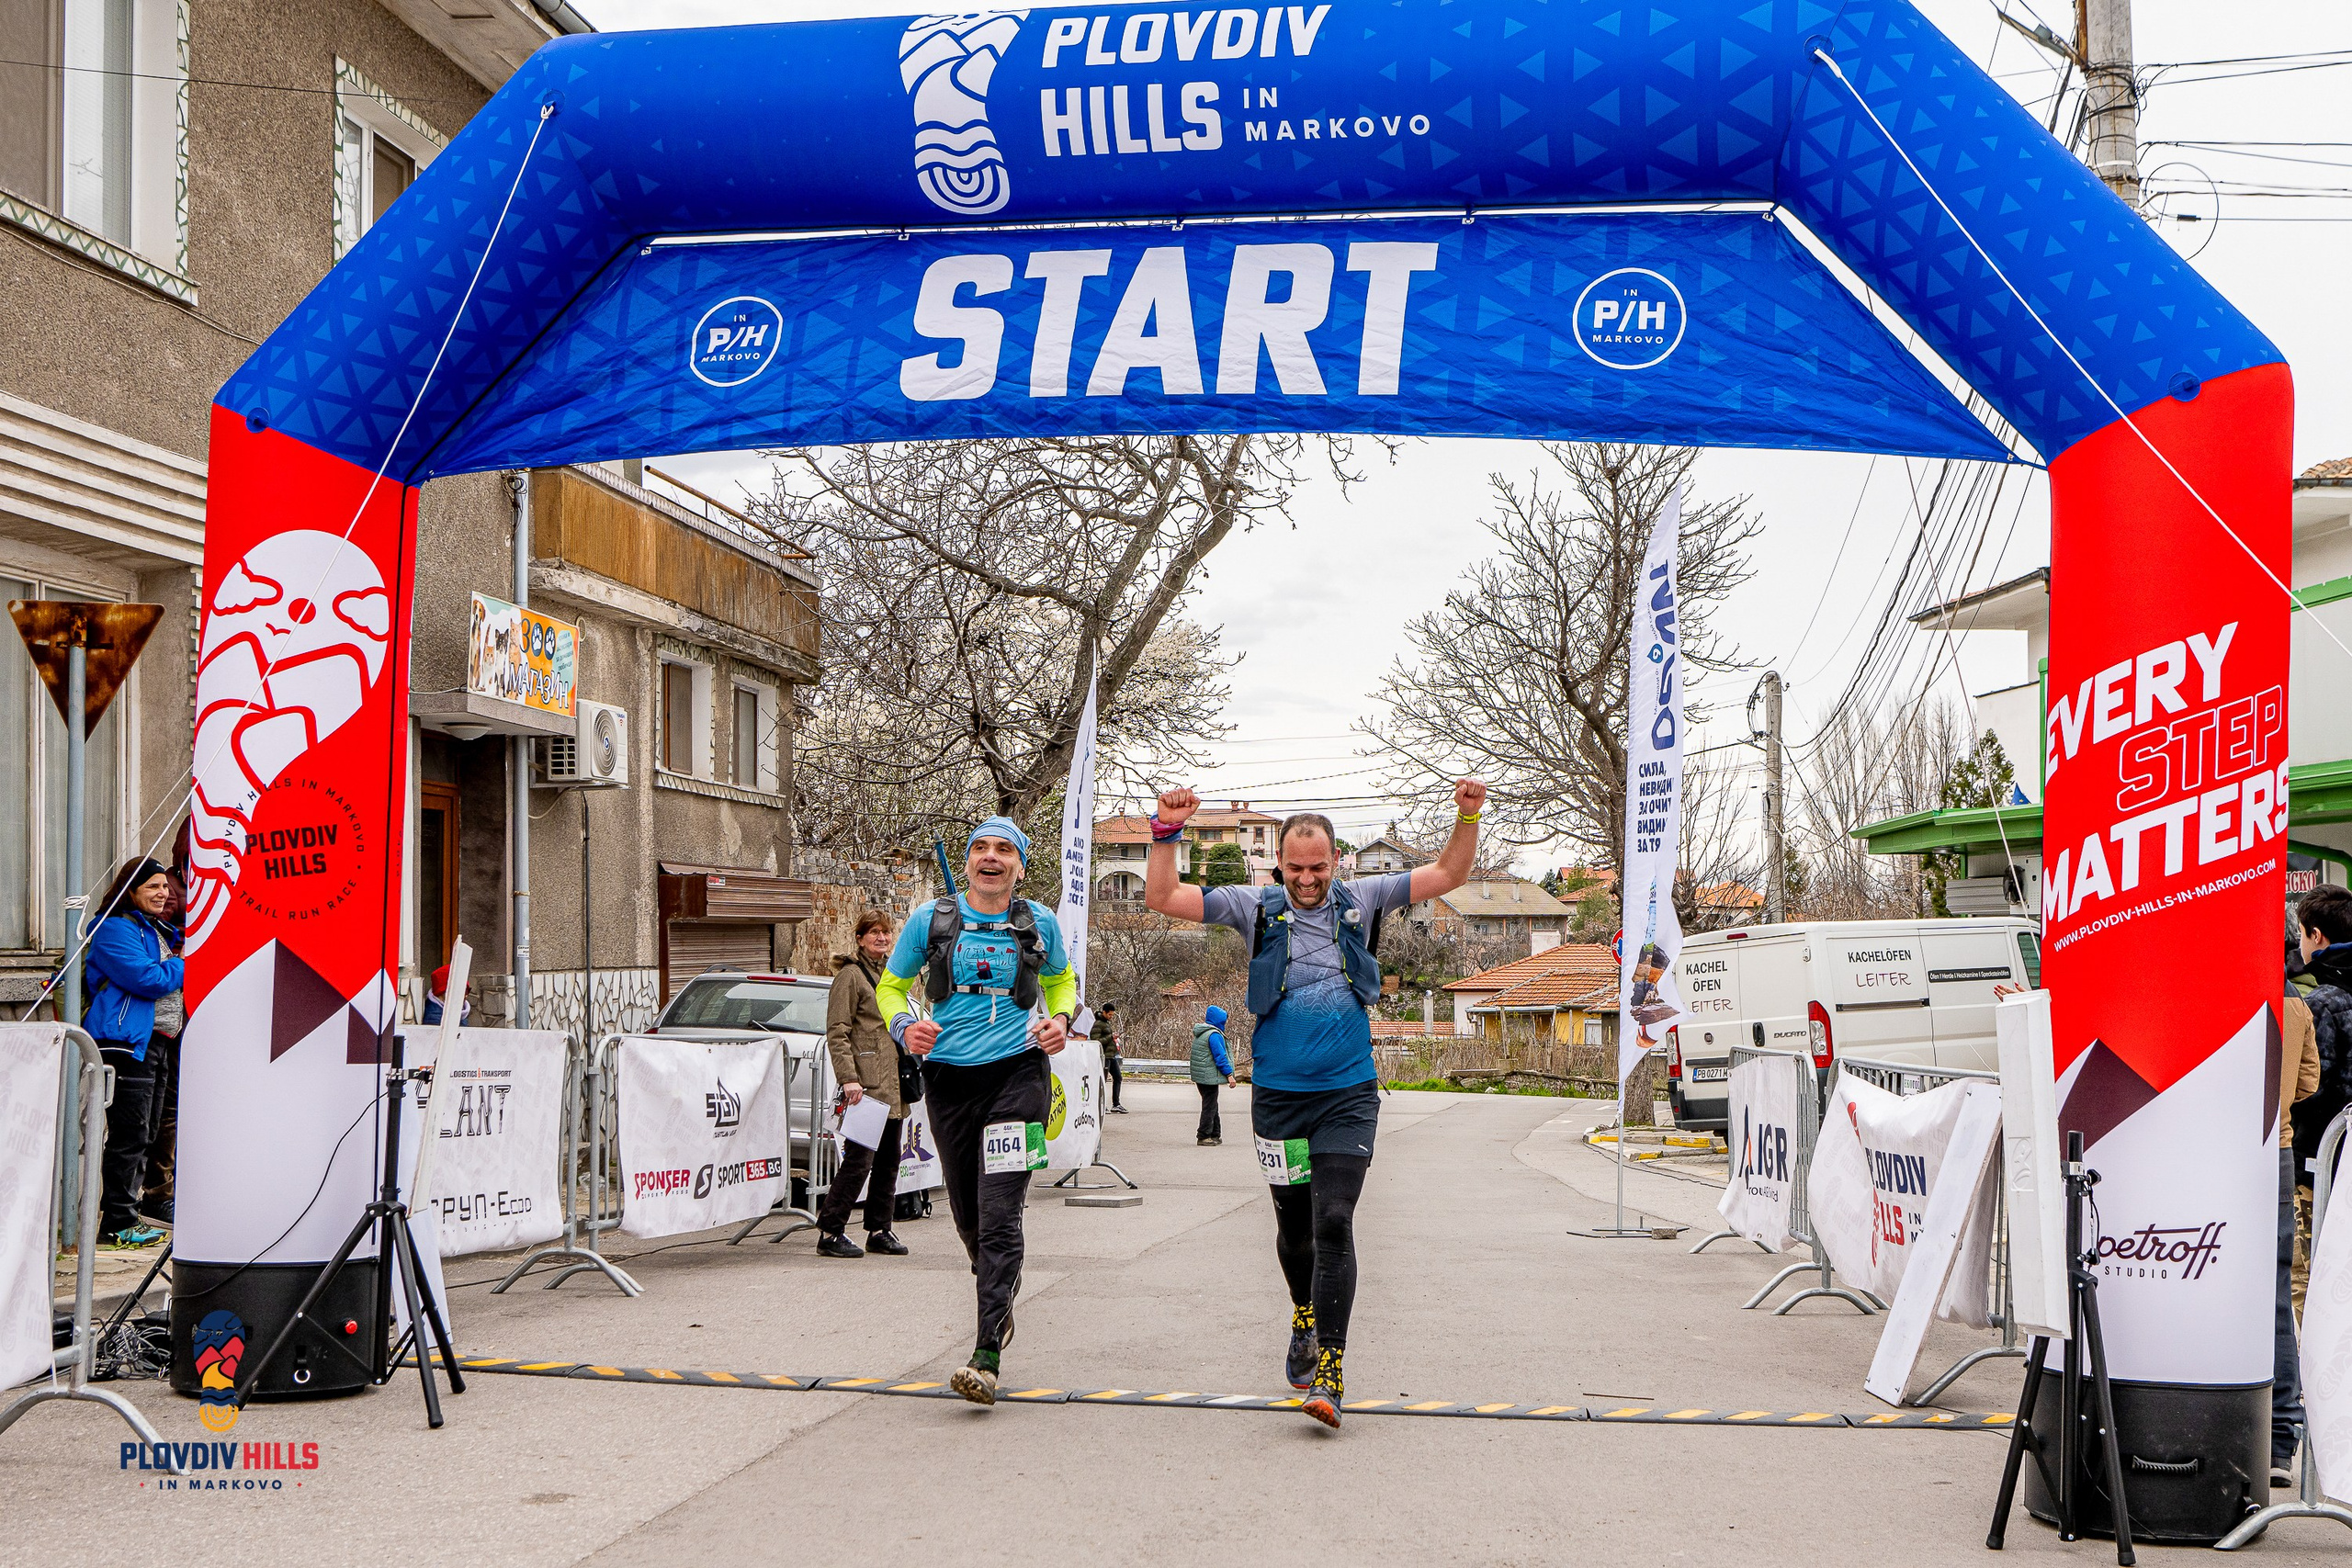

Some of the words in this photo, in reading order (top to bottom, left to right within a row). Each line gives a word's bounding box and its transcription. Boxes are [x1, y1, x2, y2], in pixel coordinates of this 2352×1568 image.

[1041, 5, 1332, 68] PLOVDIV
[1243, 87, 1278, 108] IN
[1040, 82, 1223, 157] HILLS
[1246, 115, 1430, 141] MARKOVO
[899, 243, 1439, 401] START
[1594, 300, 1666, 332] P/H
[707, 324, 769, 353] P/H
[1592, 334, 1664, 344] MARKOVO
[701, 353, 761, 363] MARKOVO
[510, 662, 569, 708] МАГАЗИН
[2045, 621, 2239, 786] EVERY
[2117, 684, 2282, 812] STEP
[1639, 761, 1667, 778] СИЛА,
[1639, 778, 1674, 796] НЕВИДИ
[223, 803, 244, 868] PLOVDIV
[247, 778, 291, 801] HILLS
[302, 779, 318, 790] IN
[325, 787, 364, 852] MARKOVO
[245, 824, 337, 855] PLOVDIV
[2042, 756, 2290, 940] MATTERS
[265, 852, 327, 880] HILLS
[239, 890, 277, 919] TRAIL
[288, 908, 320, 919] RUN
[327, 879, 356, 909] RACE
[2053, 858, 2276, 953] WWW.PLOVDIV-HILLS-IN-MARKOVO.COM
[1686, 961, 1727, 975] KACHEL
[1848, 948, 1912, 963] KACHELÖFEN
[1693, 978, 1721, 992] ÖFEN
[1856, 972, 1911, 987] LEITER
[1690, 998, 1733, 1012] EITER
[1706, 1068, 1722, 1077] 0271
[1047, 1099, 1067, 1127] ATION
[987, 1136, 1021, 1155] 4164
[634, 1169, 691, 1201] SPONSER
[1865, 1147, 1927, 1196] POVDIV
[1880, 1201, 1905, 1247] ILLS
[1908, 1213, 1922, 1224] IN
[2105, 1265, 2167, 1280] STUDIO
